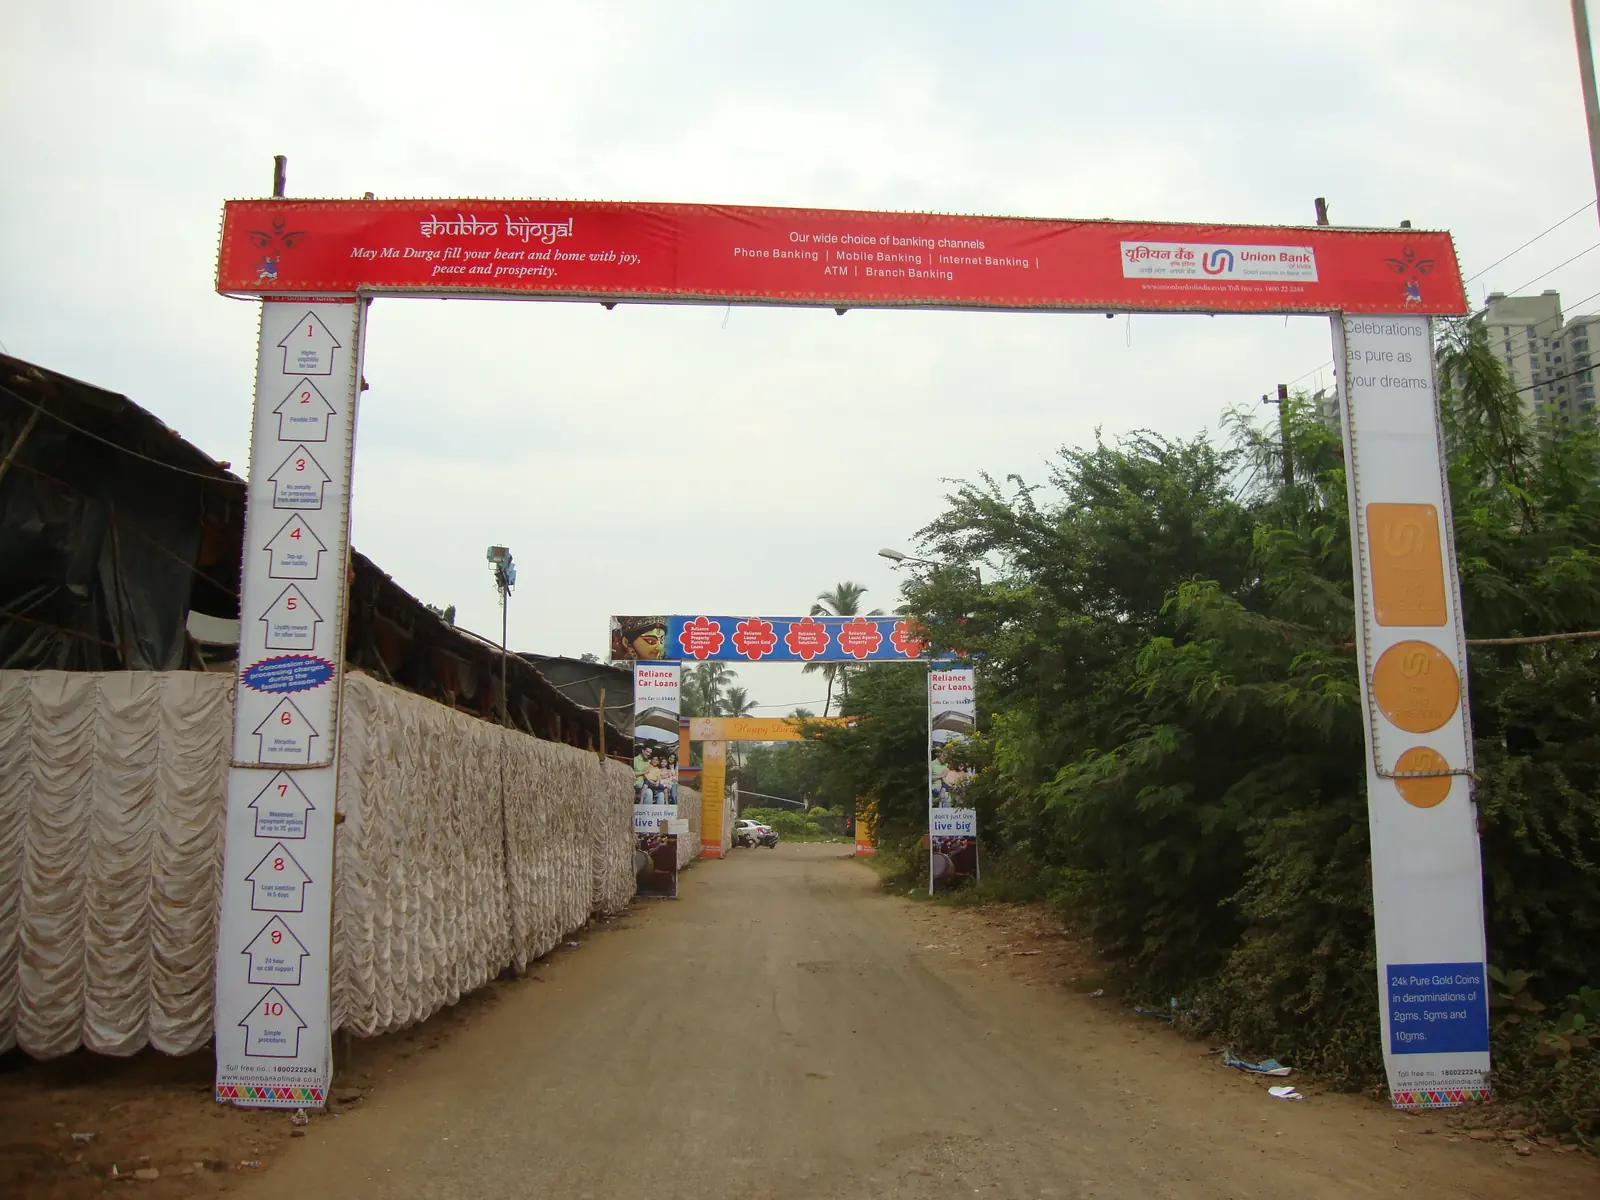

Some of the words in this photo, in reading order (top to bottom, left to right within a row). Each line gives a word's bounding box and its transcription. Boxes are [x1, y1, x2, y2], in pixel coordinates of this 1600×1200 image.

[420, 214, 498, 237] shubho
[790, 232, 810, 242] Our
[812, 232, 838, 244] wide
[841, 234, 877, 245] choice
[879, 235, 890, 246] of
[892, 236, 935, 249] banking
[938, 238, 986, 250] channels
[350, 248, 377, 260] May
[380, 248, 400, 258] Ma
[403, 248, 440, 261] Durga
[443, 247, 462, 262] fill
[464, 250, 491, 261] your
[494, 248, 524, 260] heart
[528, 250, 551, 260] and
[554, 250, 586, 262] home
[589, 251, 616, 262] with
[617, 251, 640, 265] joy,
[734, 248, 769, 258] Phone
[772, 248, 818, 261] Banking
[836, 251, 874, 262] Mobile
[877, 252, 922, 264] Banking
[939, 254, 982, 266] Internet
[986, 256, 1029, 268] Banking
[1126, 246, 1171, 262] यूनियन
[1241, 252, 1276, 262] Union
[1280, 252, 1310, 262] Bank
[431, 264, 466, 276] peace
[469, 263, 492, 275] and
[494, 264, 558, 278] prosperity.
[824, 266, 848, 276] ATM
[866, 267, 905, 278] Branch
[908, 268, 954, 280] Banking
[308, 325, 312, 336] 1
[1346, 320, 1422, 336] Celebrations
[1366, 351, 1393, 364] pure
[1398, 352, 1412, 362] as
[1380, 375, 1430, 388] dreams.
[300, 392, 310, 403] 2
[296, 459, 305, 471] 3
[290, 528, 301, 540] 4
[287, 598, 297, 610] 5
[258, 662, 303, 671] Concession
[250, 669, 292, 680] processing
[281, 712, 292, 725] 6
[734, 723, 768, 737] Happy
[277, 785, 288, 797] 7
[934, 822, 952, 830] live
[956, 822, 972, 832] big
[274, 858, 284, 871] 8
[271, 930, 282, 944] 9
[1392, 976, 1408, 986] 24k
[1410, 976, 1430, 986] Pure
[1432, 975, 1452, 985] Gold
[1455, 974, 1480, 984] Coins
[1392, 994, 1400, 1002] in
[1403, 993, 1466, 1002] denominations
[1468, 992, 1476, 1000] of
[264, 1002, 283, 1016] 10
[1424, 1011, 1448, 1021] 5gms
[1450, 1010, 1466, 1019] and
[1396, 1032, 1427, 1042] 10gms.
